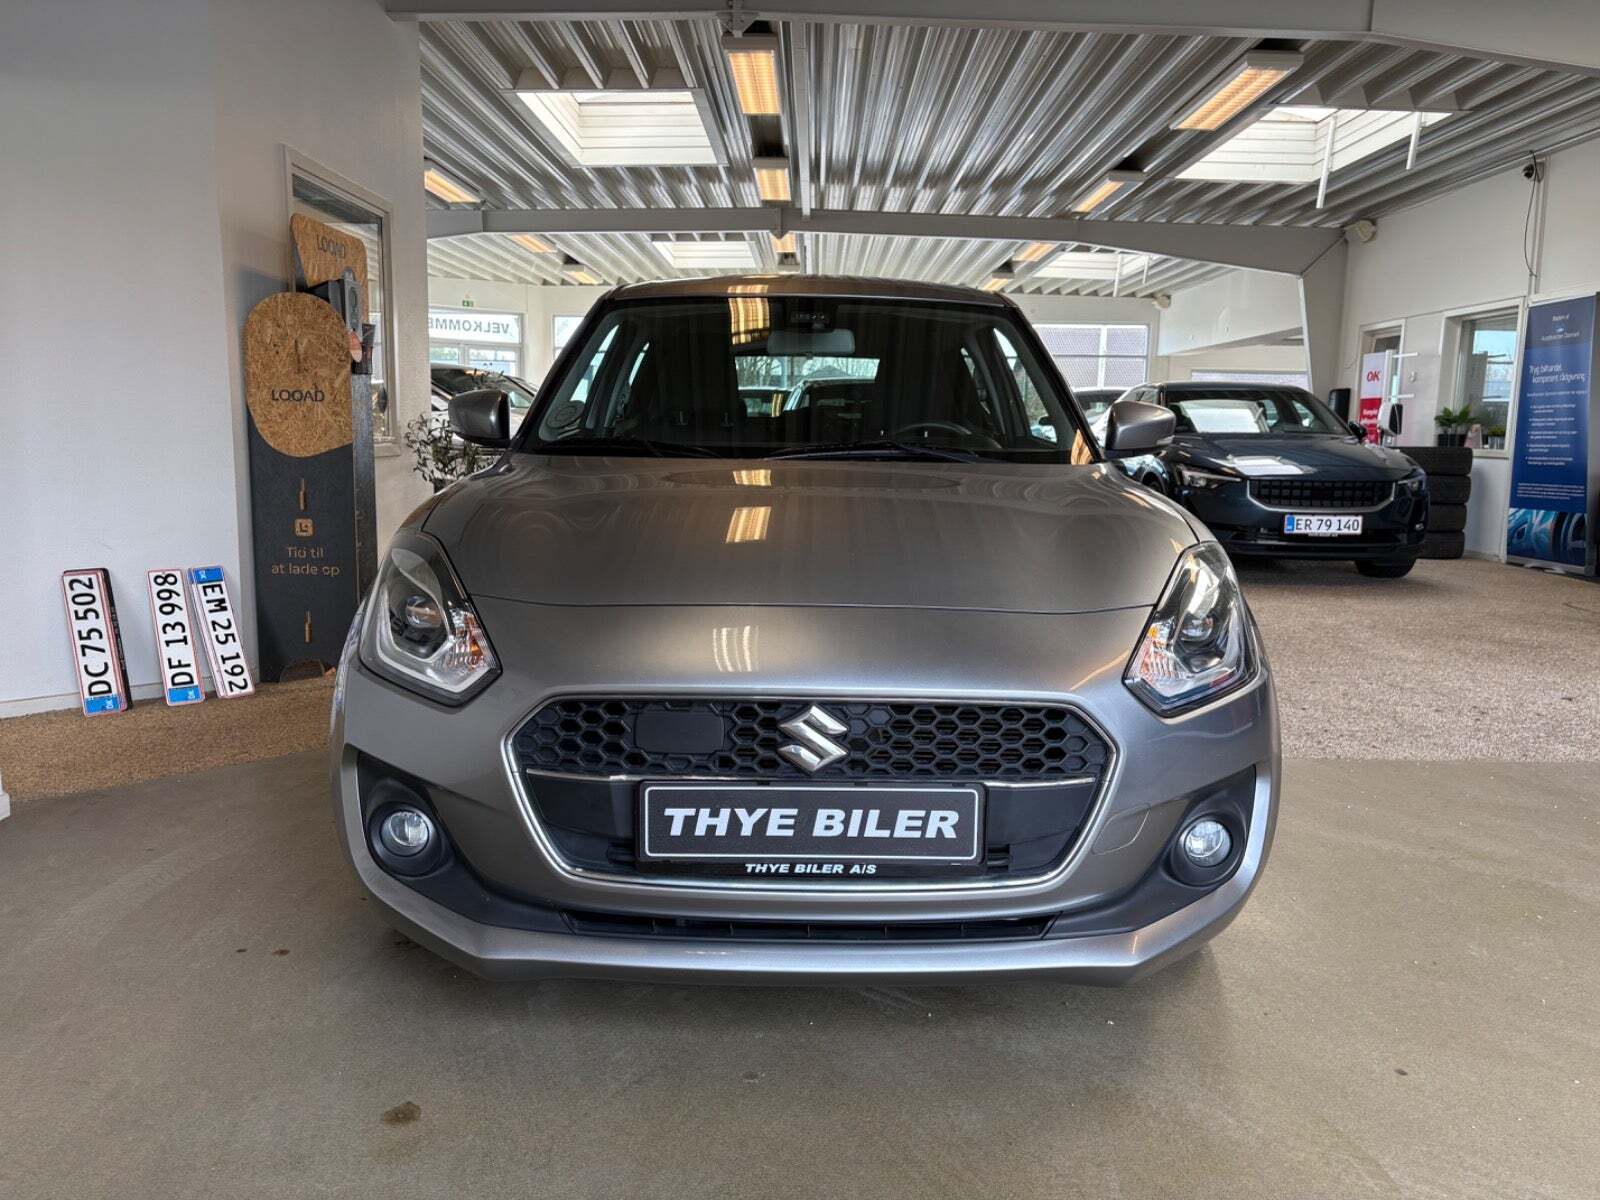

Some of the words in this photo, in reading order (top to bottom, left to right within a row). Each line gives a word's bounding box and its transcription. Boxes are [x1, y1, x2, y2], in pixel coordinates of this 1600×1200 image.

[1366, 371, 1381, 382] OK
[271, 389, 325, 402] LOOAD
[1295, 519, 1313, 531] ER
[1316, 519, 1333, 531] 79
[1336, 519, 1360, 532] 140
[311, 546, 324, 558] til
[271, 565, 285, 575] at
[289, 563, 318, 575] lade
[68, 577, 100, 621] 502
[153, 573, 183, 616] 998
[202, 584, 228, 613] EM
[77, 627, 106, 657] 75
[161, 621, 188, 648] 13
[211, 618, 236, 645] 25
[84, 662, 113, 697] DC
[167, 657, 195, 687] DF
[220, 652, 248, 692] 192
[663, 808, 798, 837] THYE
[812, 808, 960, 839] BILER
[745, 863, 790, 874] THYE
[794, 863, 845, 874] BILER
[849, 864, 877, 875] A/S
